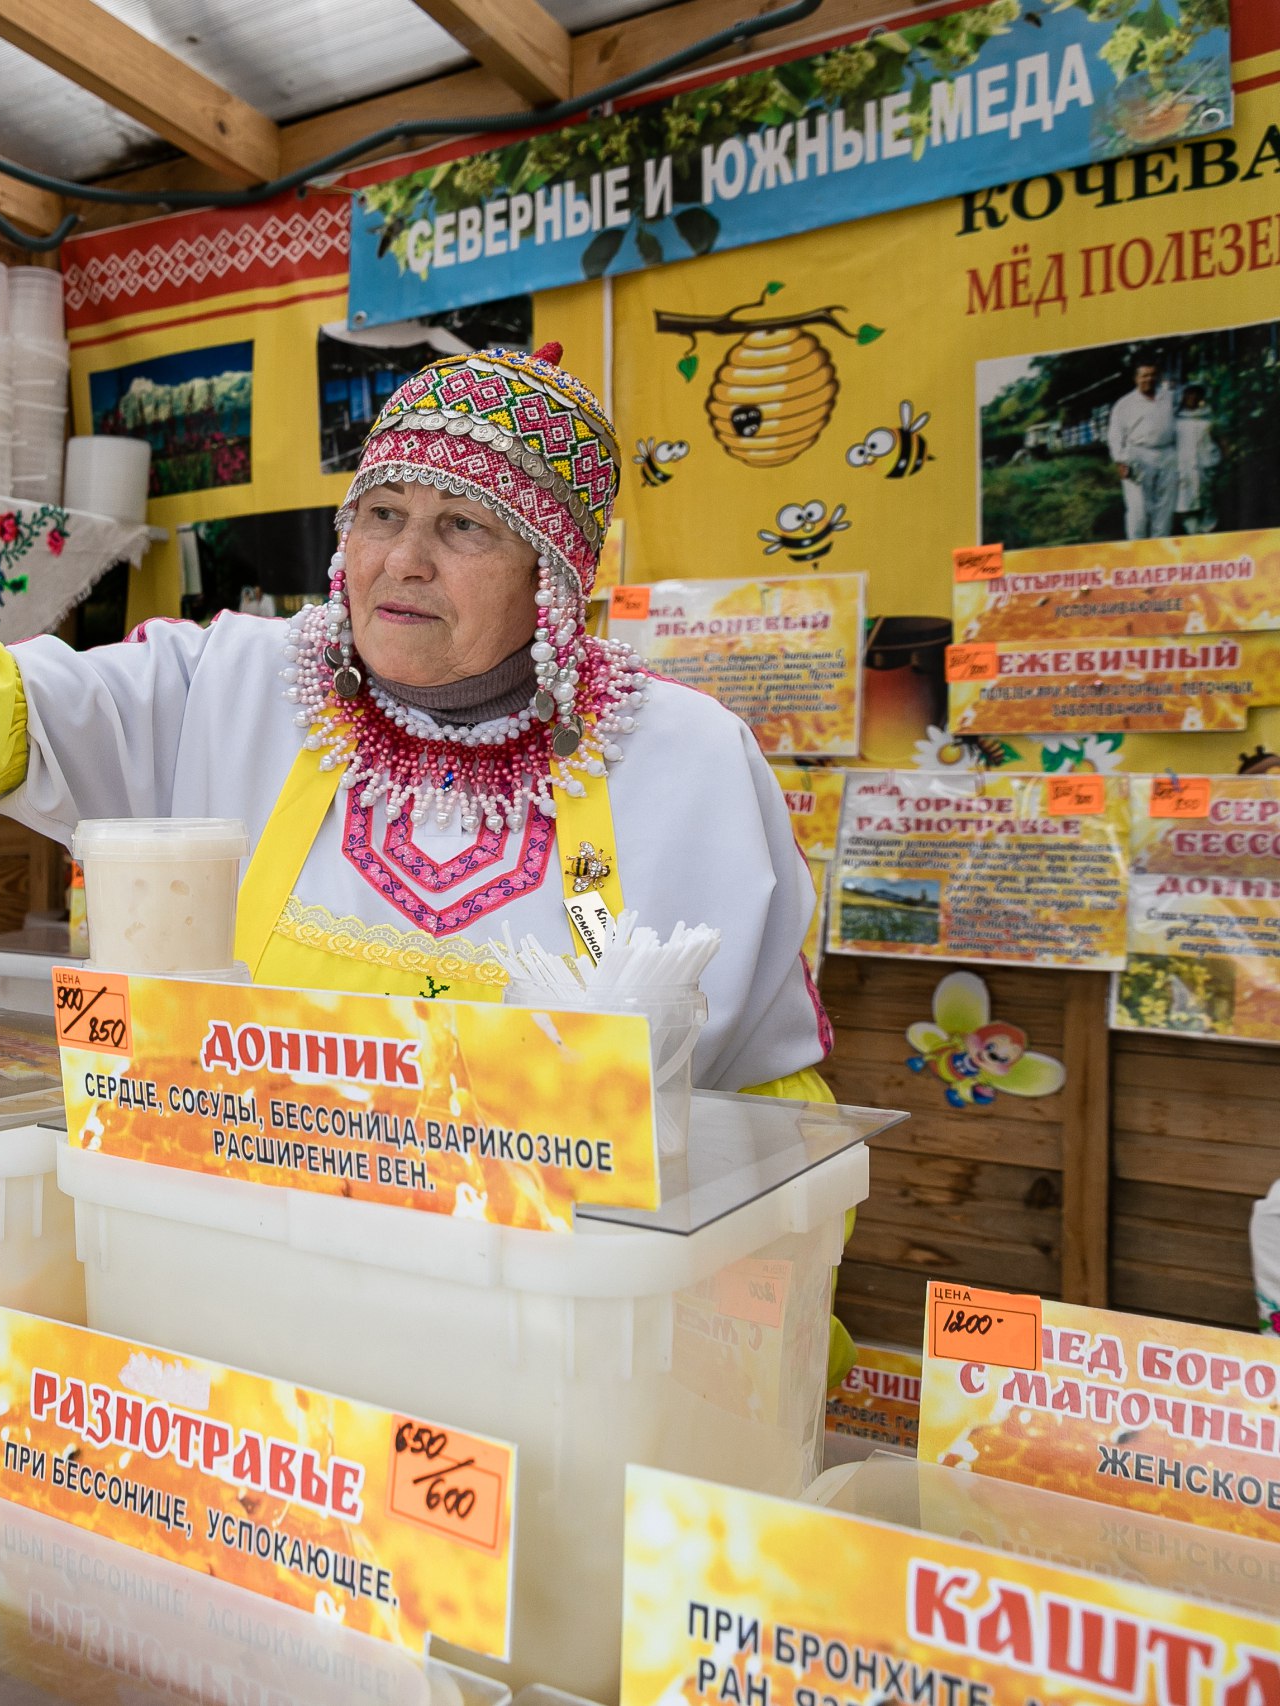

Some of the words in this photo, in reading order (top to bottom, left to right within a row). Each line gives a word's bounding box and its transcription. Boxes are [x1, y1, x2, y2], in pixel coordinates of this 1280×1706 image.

[406, 165, 631, 273] СЕВЕРНЫЕ
[644, 155, 674, 218] И
[701, 92, 912, 205] ЮЖНЫЕ
[931, 43, 1095, 147] МЕДА
[965, 244, 1068, 318] МЁД
[1113, 558, 1253, 587] ВАЛЕРИАНОЙ
[654, 612, 832, 637] ЯБЛОНЕВЫЙ
[999, 640, 1240, 674] ЕЖЕВИЧНЫЙ
[856, 817, 1082, 835] РАЗНОТРАВЬЕ
[895, 797, 1014, 813] ГОРНОЕ
[56, 973, 81, 985] ЦЕНА
[203, 1022, 421, 1086] ДОННИК
[84, 1072, 163, 1116] СЕРДЦЕ,
[168, 1084, 263, 1131] СОСУДЫ,
[212, 1130, 370, 1183] РАСШИРЕНИЕ
[379, 1152, 436, 1193] ВЕН.
[934, 1287, 971, 1301] ЦЕНА
[959, 1362, 986, 1394] С
[32, 1371, 363, 1518] РАЗНОТРАВЬЕ
[4, 1441, 47, 1480] ПРИ
[53, 1453, 194, 1540] БЕССОНИЦЕ,
[207, 1506, 399, 1607] УСПОКАЮЩЕЕ.
[689, 1602, 759, 1655] ПРИ
